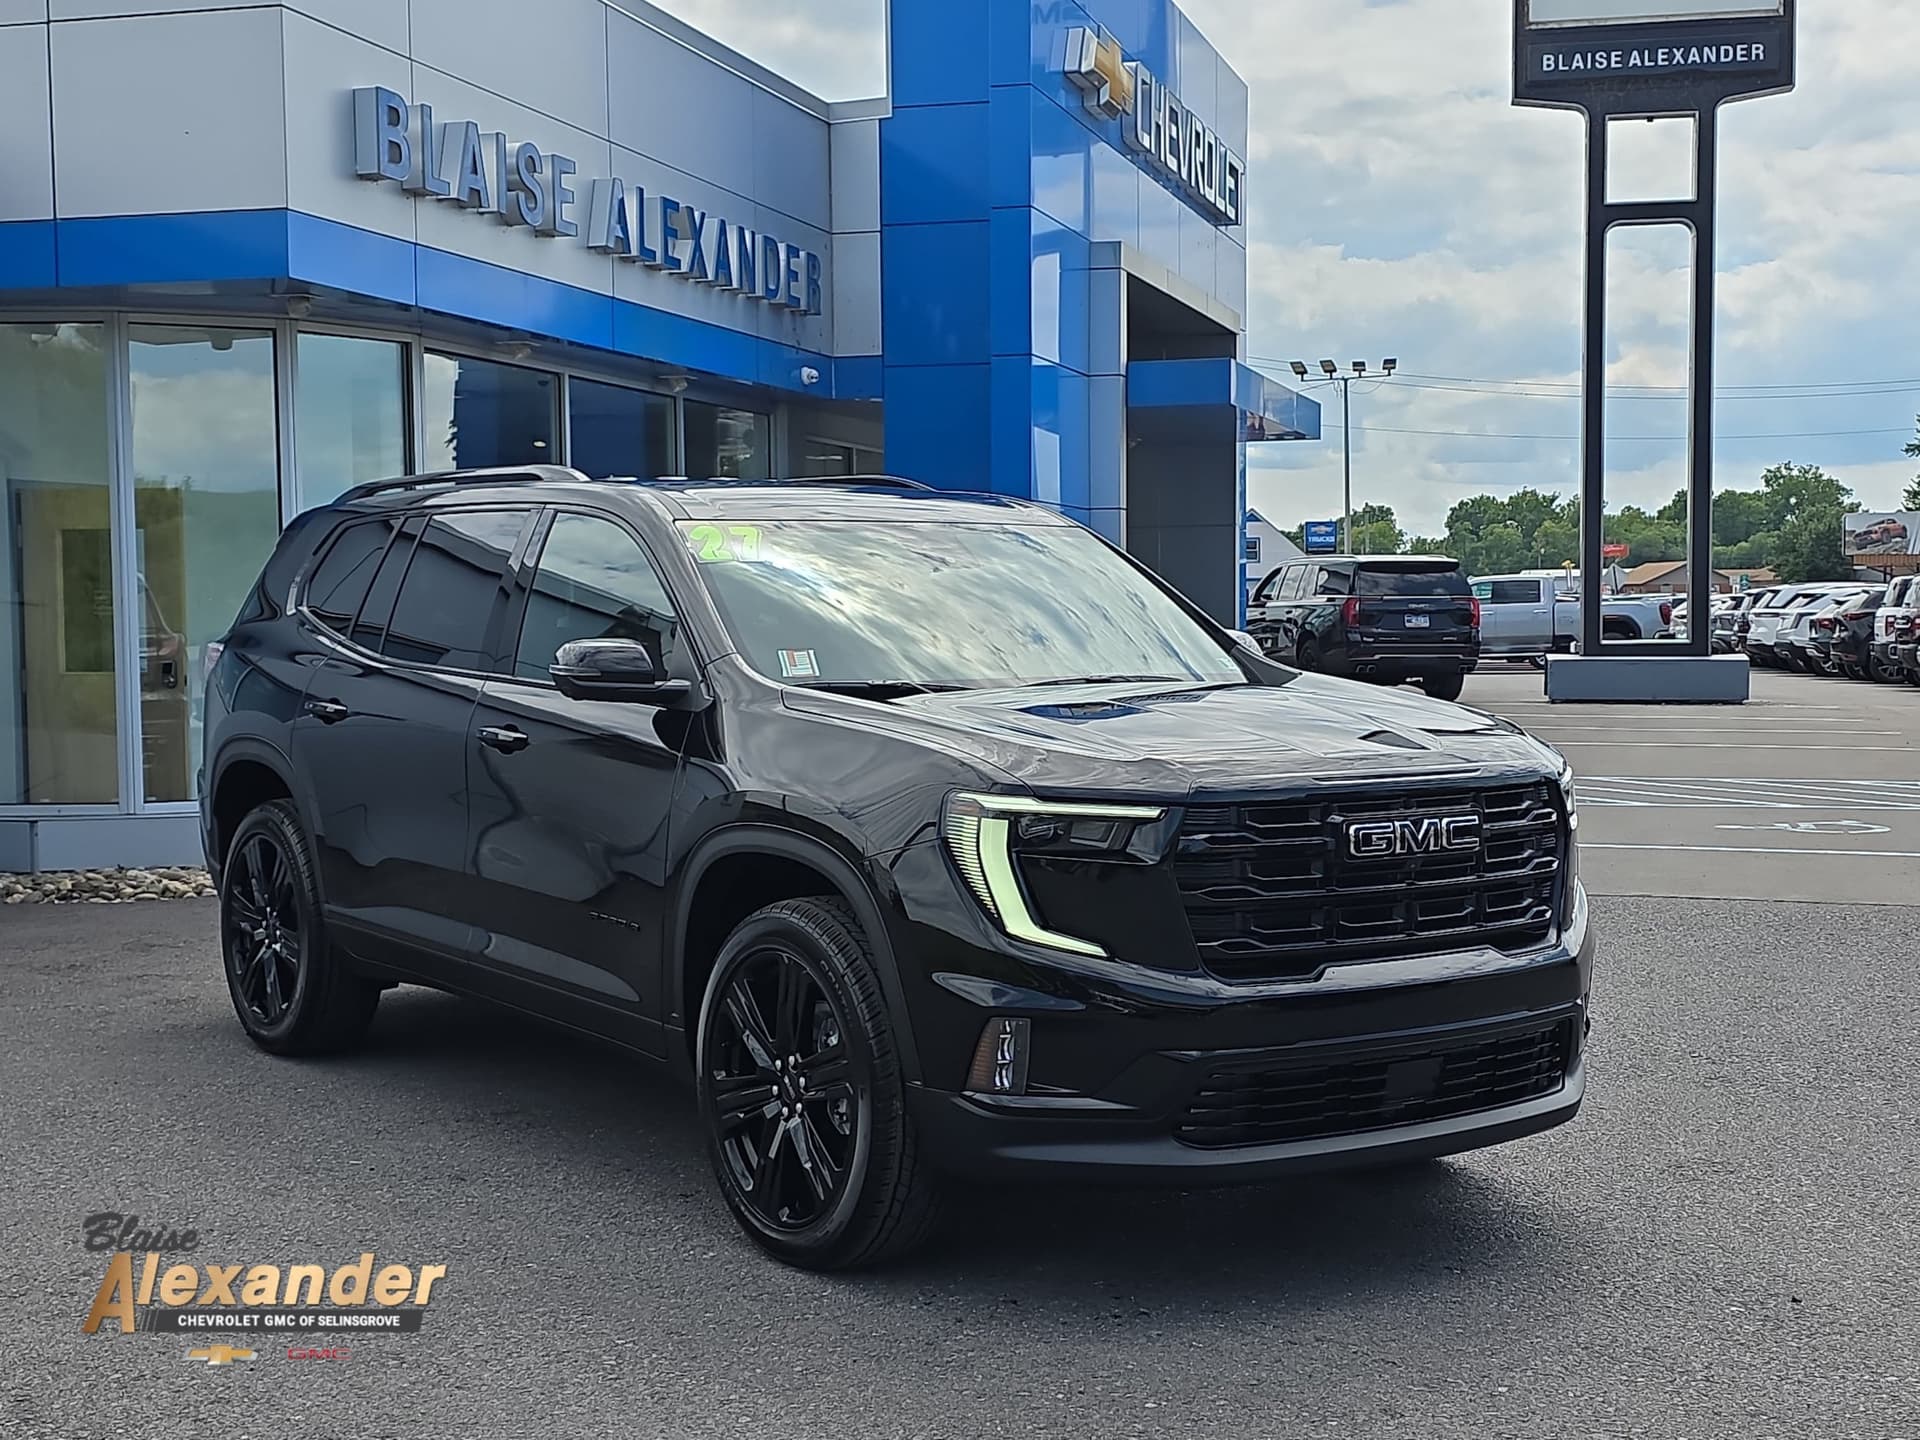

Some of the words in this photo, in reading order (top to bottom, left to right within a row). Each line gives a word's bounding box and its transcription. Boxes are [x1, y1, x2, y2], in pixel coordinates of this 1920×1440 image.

[1542, 50, 1622, 72] BLAISE
[1628, 43, 1766, 68] ALEXANDER
[1121, 61, 1245, 226] CHEVROLET
[353, 86, 578, 238] BLAISE
[587, 178, 822, 316] ALEXANDER
[688, 525, 763, 562] 27
[1349, 815, 1480, 857] GMC
